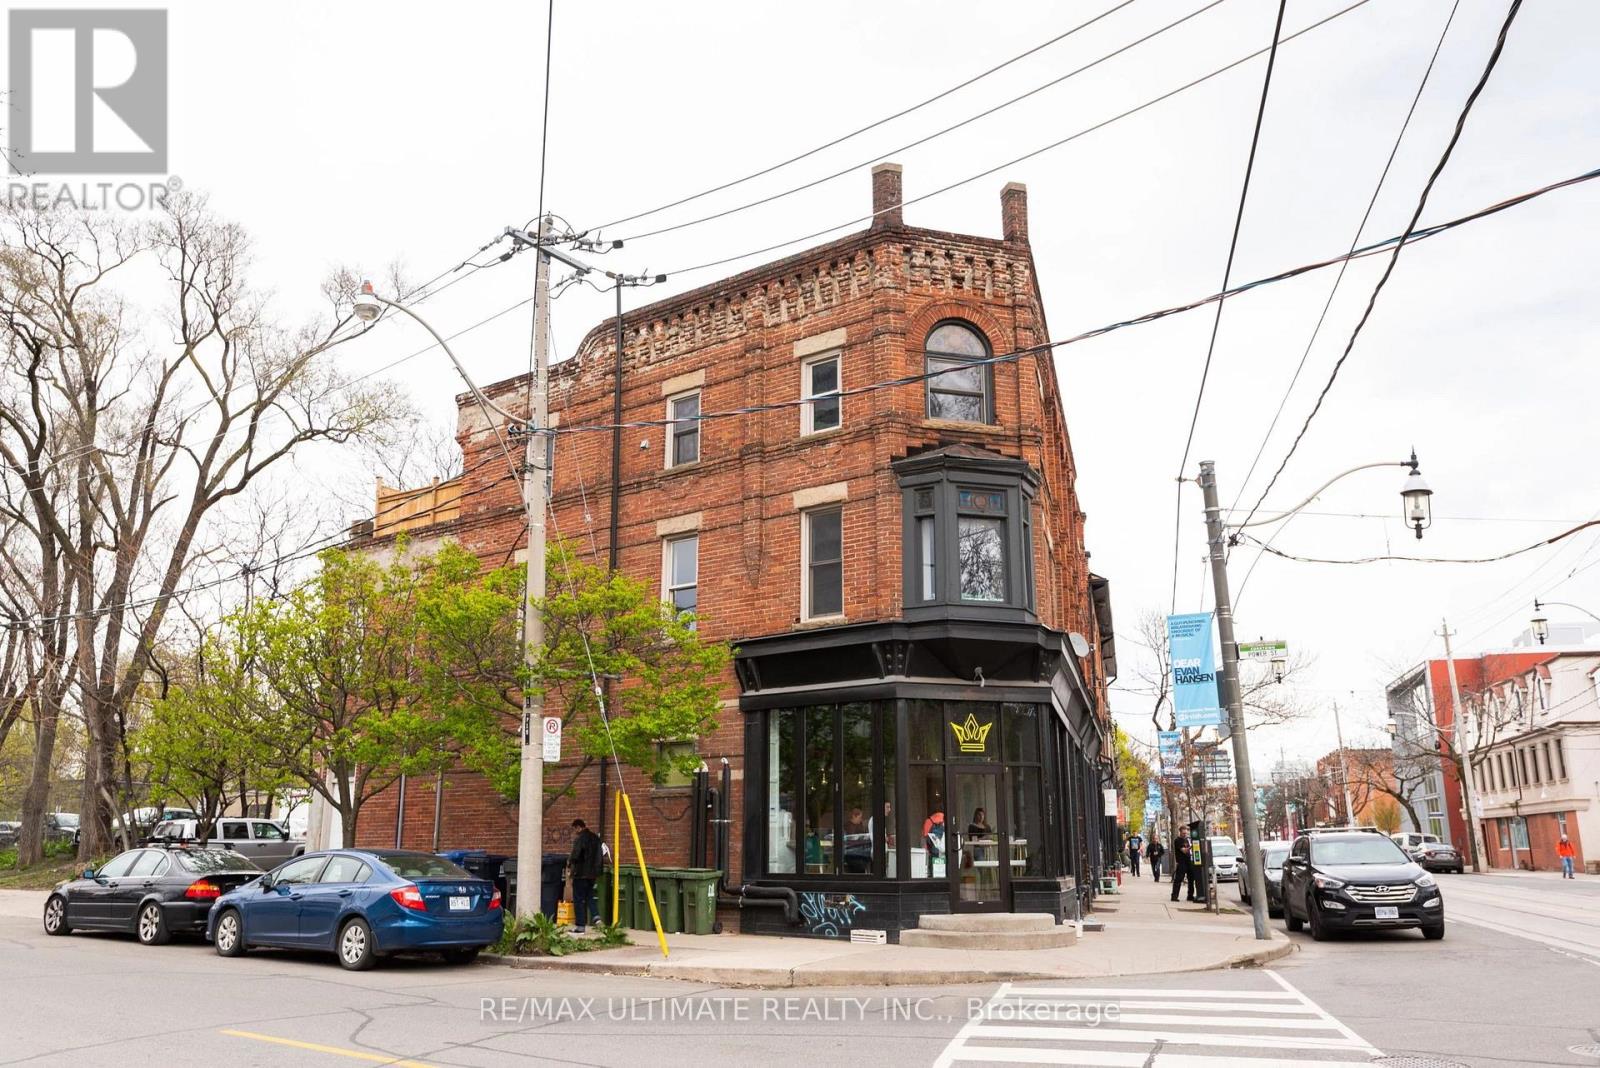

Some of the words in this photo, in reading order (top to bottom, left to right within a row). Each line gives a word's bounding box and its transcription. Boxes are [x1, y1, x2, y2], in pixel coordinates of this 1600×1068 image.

[1173, 658, 1201, 667] DEAR
[1174, 666, 1200, 676] EVAN
[1175, 673, 1214, 684] HANSEN
